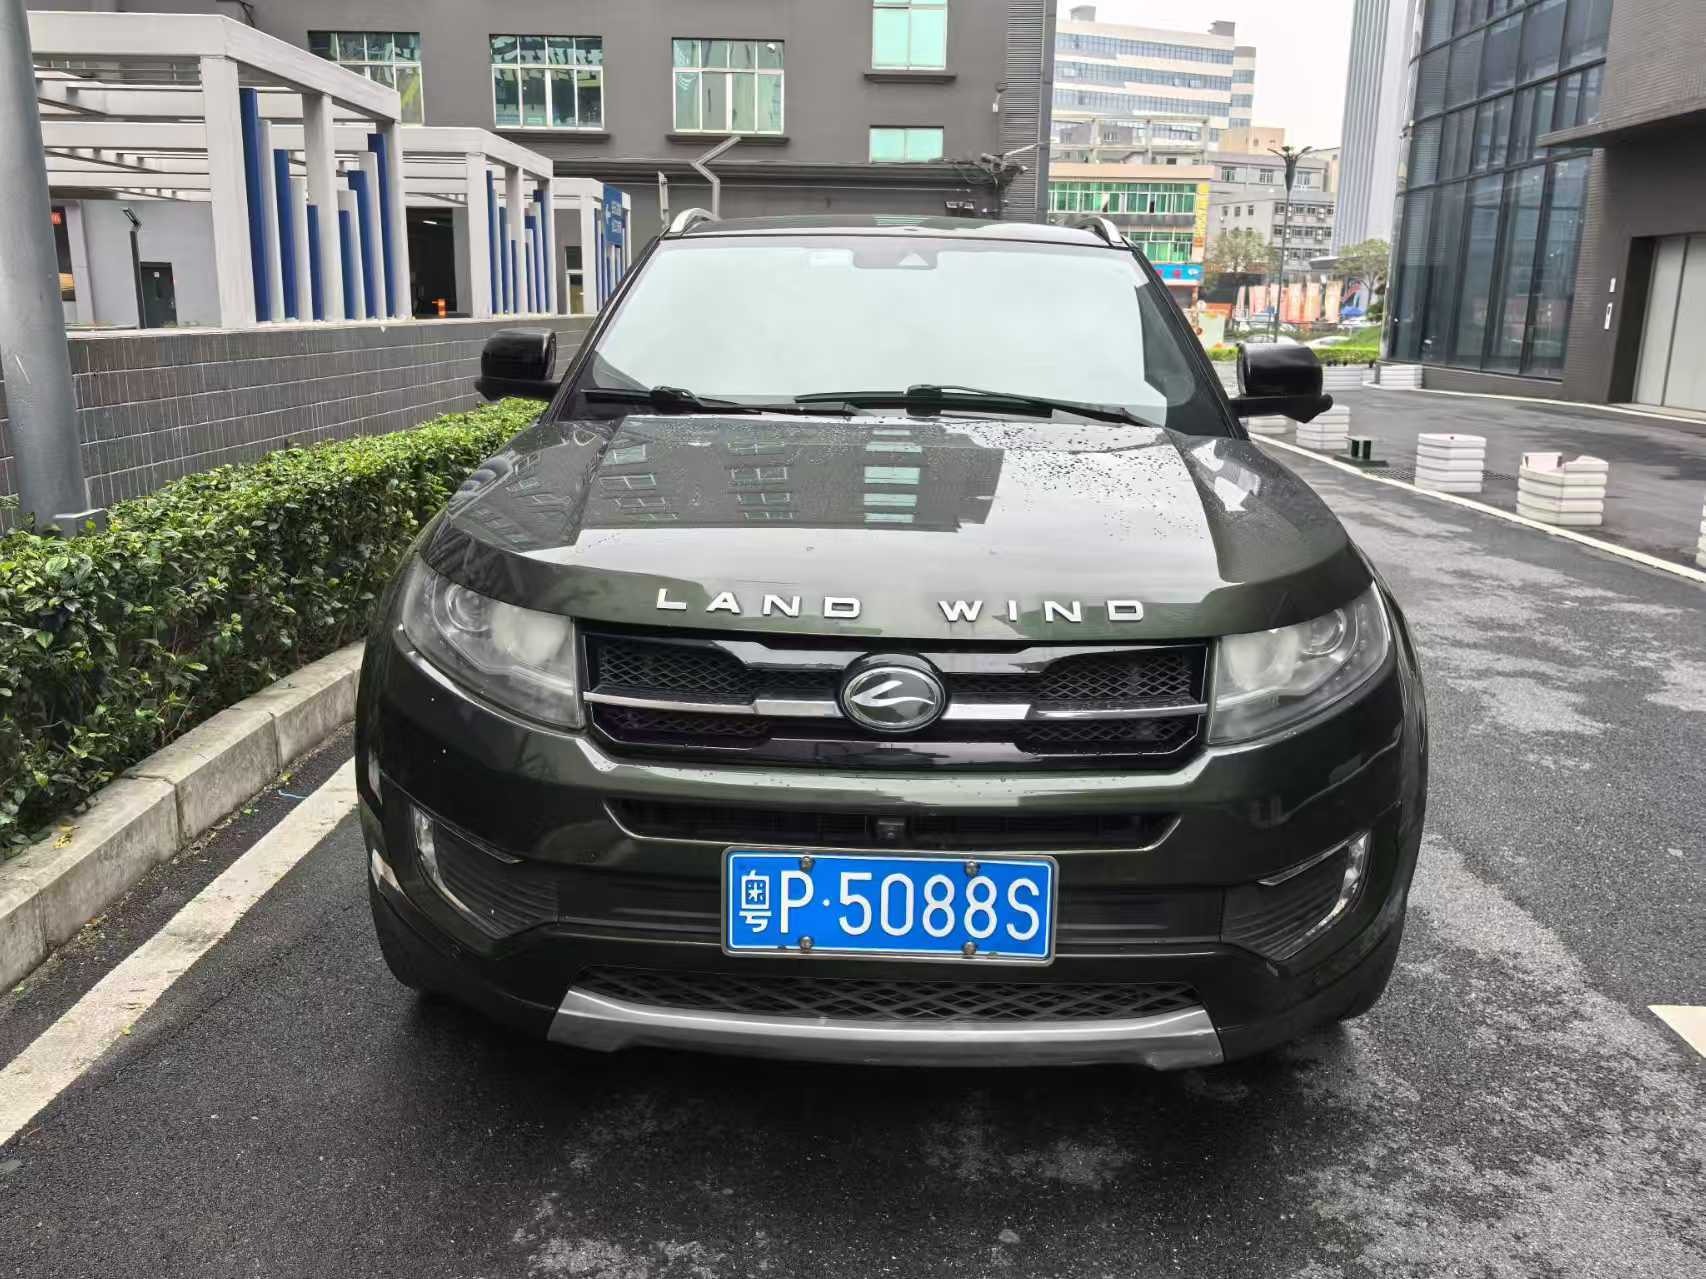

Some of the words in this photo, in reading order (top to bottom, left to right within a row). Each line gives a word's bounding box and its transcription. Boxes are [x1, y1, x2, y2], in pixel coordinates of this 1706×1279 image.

[656, 588, 862, 619] LAND
[938, 599, 1145, 623] WIND
[738, 869, 1041, 941] 粤P·5088S
